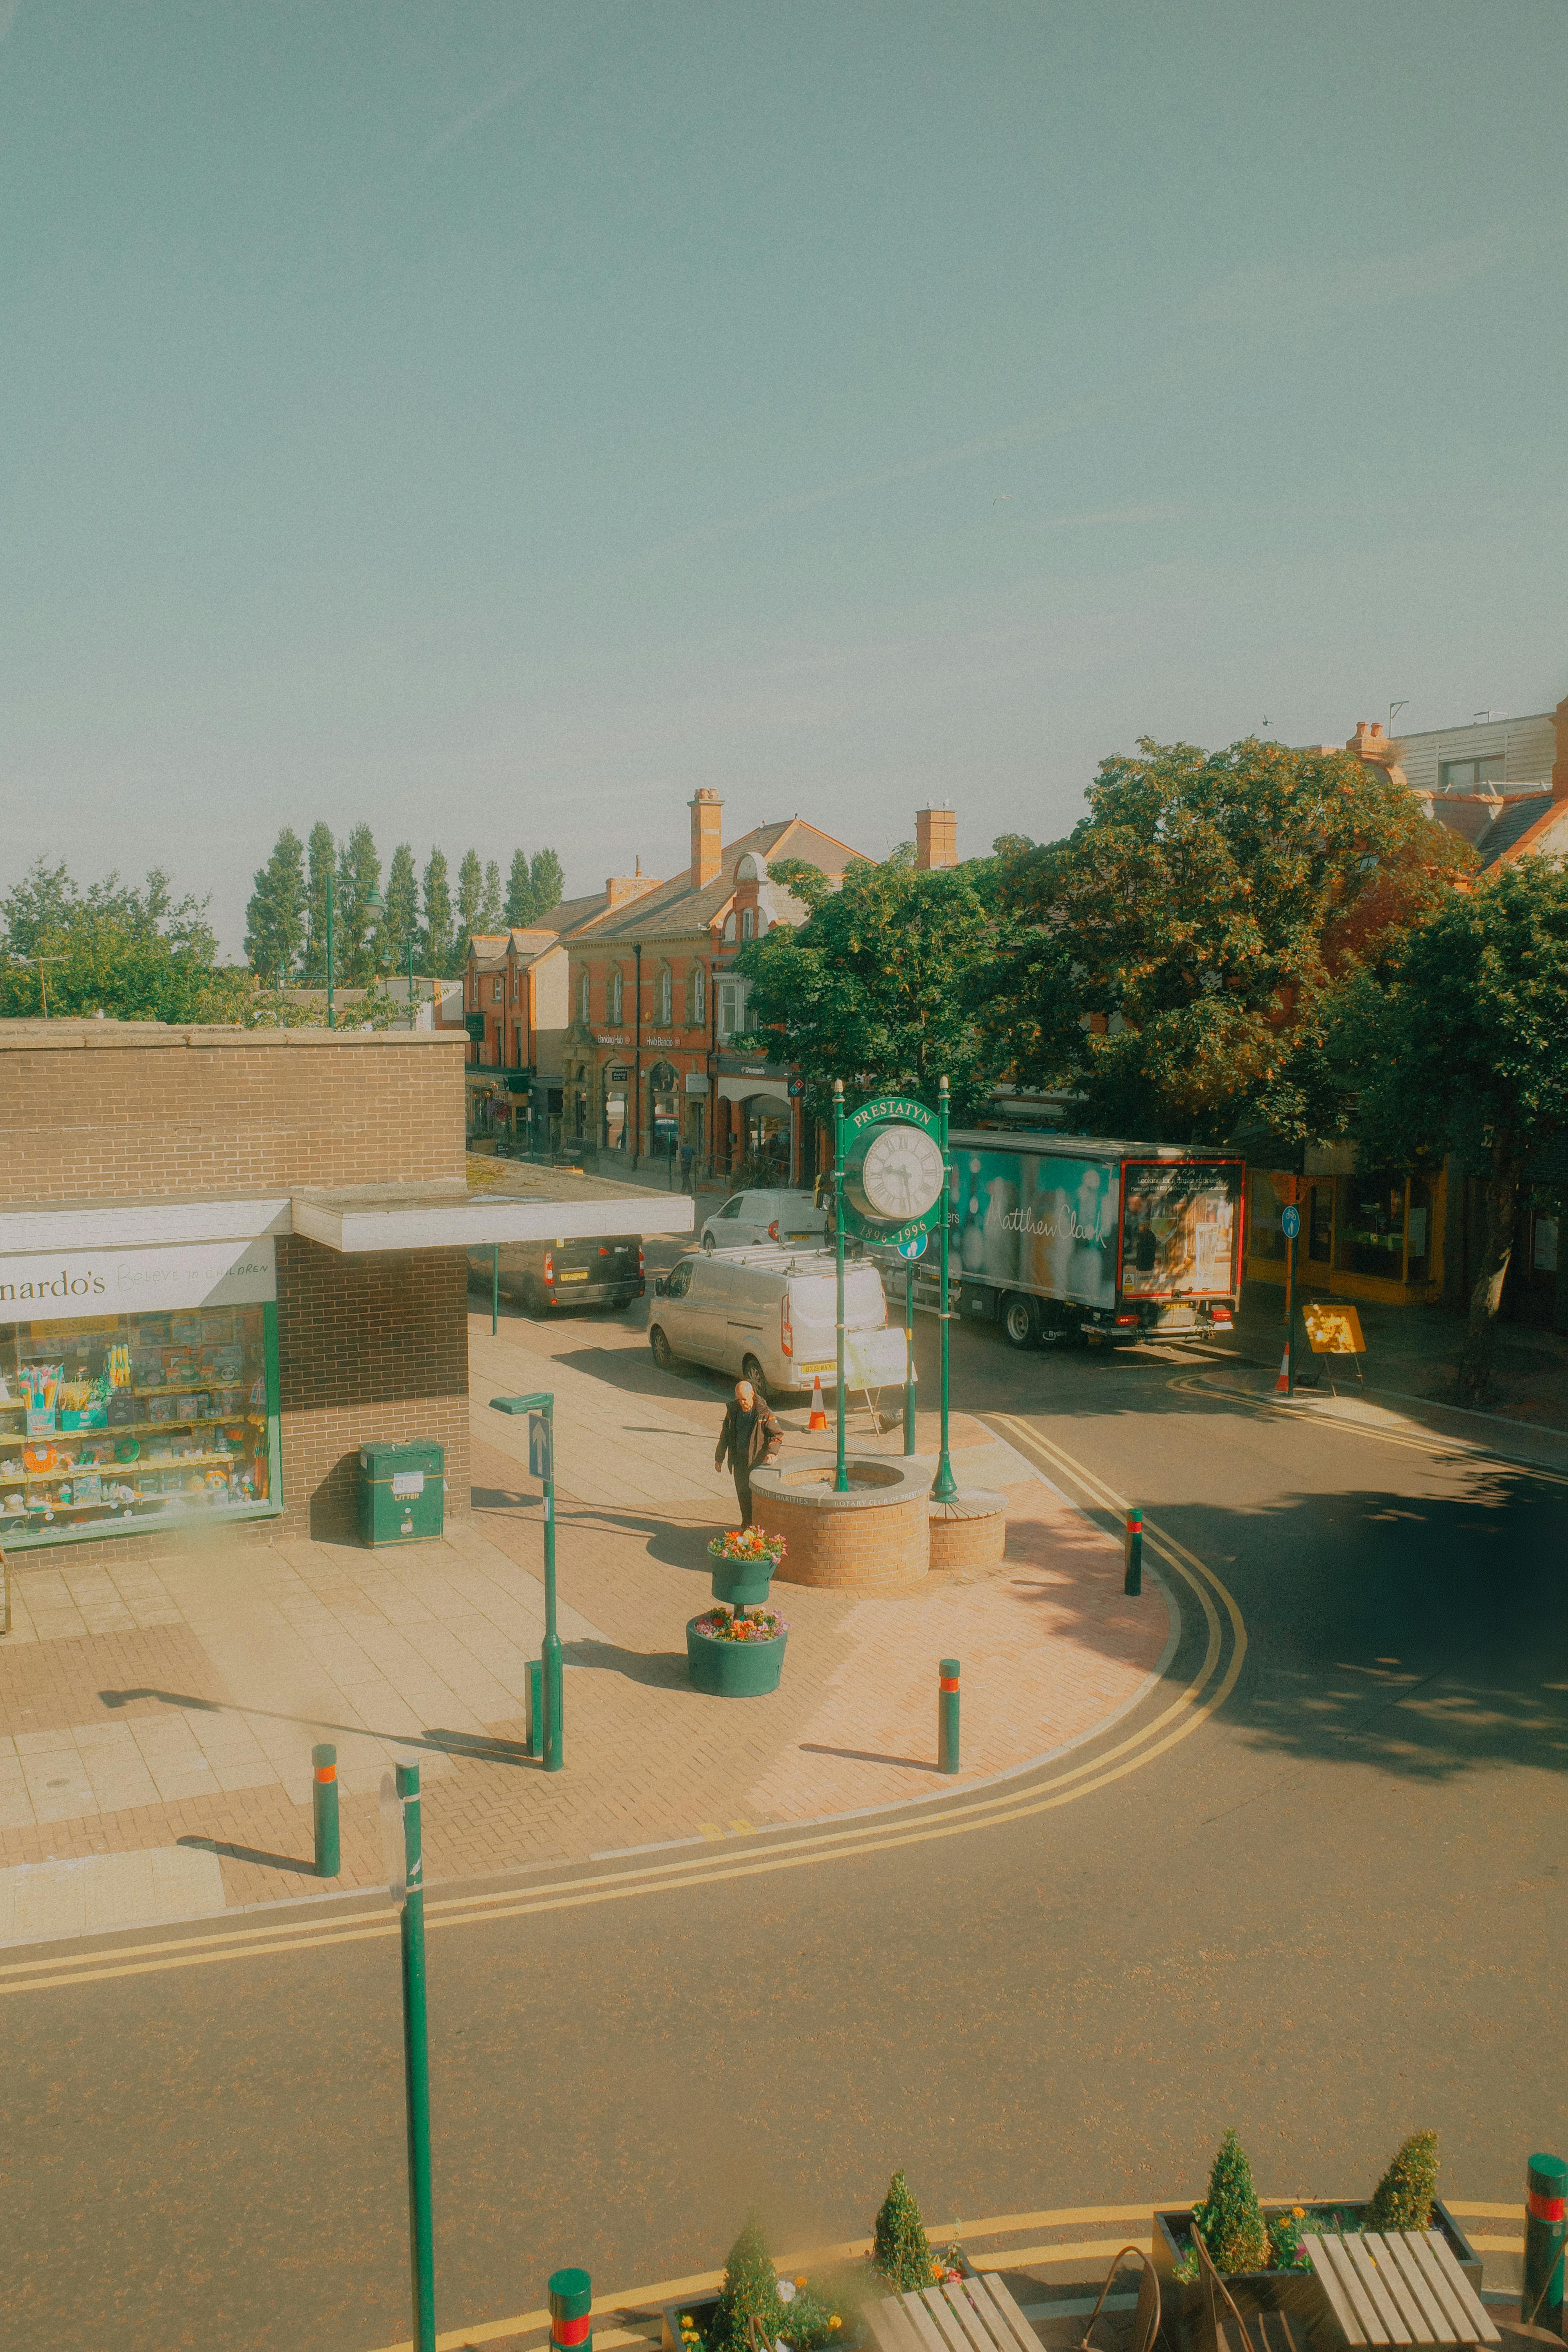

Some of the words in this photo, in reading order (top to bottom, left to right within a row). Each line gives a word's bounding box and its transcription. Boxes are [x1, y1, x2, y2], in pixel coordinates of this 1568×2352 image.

[598, 1034, 614, 1046] Banking
[614, 1035, 623, 1044] Hub
[647, 1036, 657, 1046] Hwb
[658, 1037, 673, 1046] Bancio
[745, 1066, 765, 1075] Domino's
[853, 1101, 931, 1128] PRESTATYN
[1137, 1177, 1161, 1185] Looking
[1196, 1177, 1222, 1185] supplier?
[986, 1195, 1059, 1237] Matthew
[1059, 1204, 1107, 1248] Clak
[860, 1225, 887, 1243] 1896
[898, 1220, 926, 1242] 1996
[0, 1270, 105, 1301] nardo's
[206, 1263, 268, 1278] CHILDREN
[1048, 1330, 1066, 1338] Ryder
[805, 1364, 819, 1372] BX19
[394, 1493, 420, 1502] LITTER
[756, 1487, 771, 1497] LOCAL
[772, 1493, 808, 1504] CHARITIES
[868, 1497, 888, 1506] CLUB
